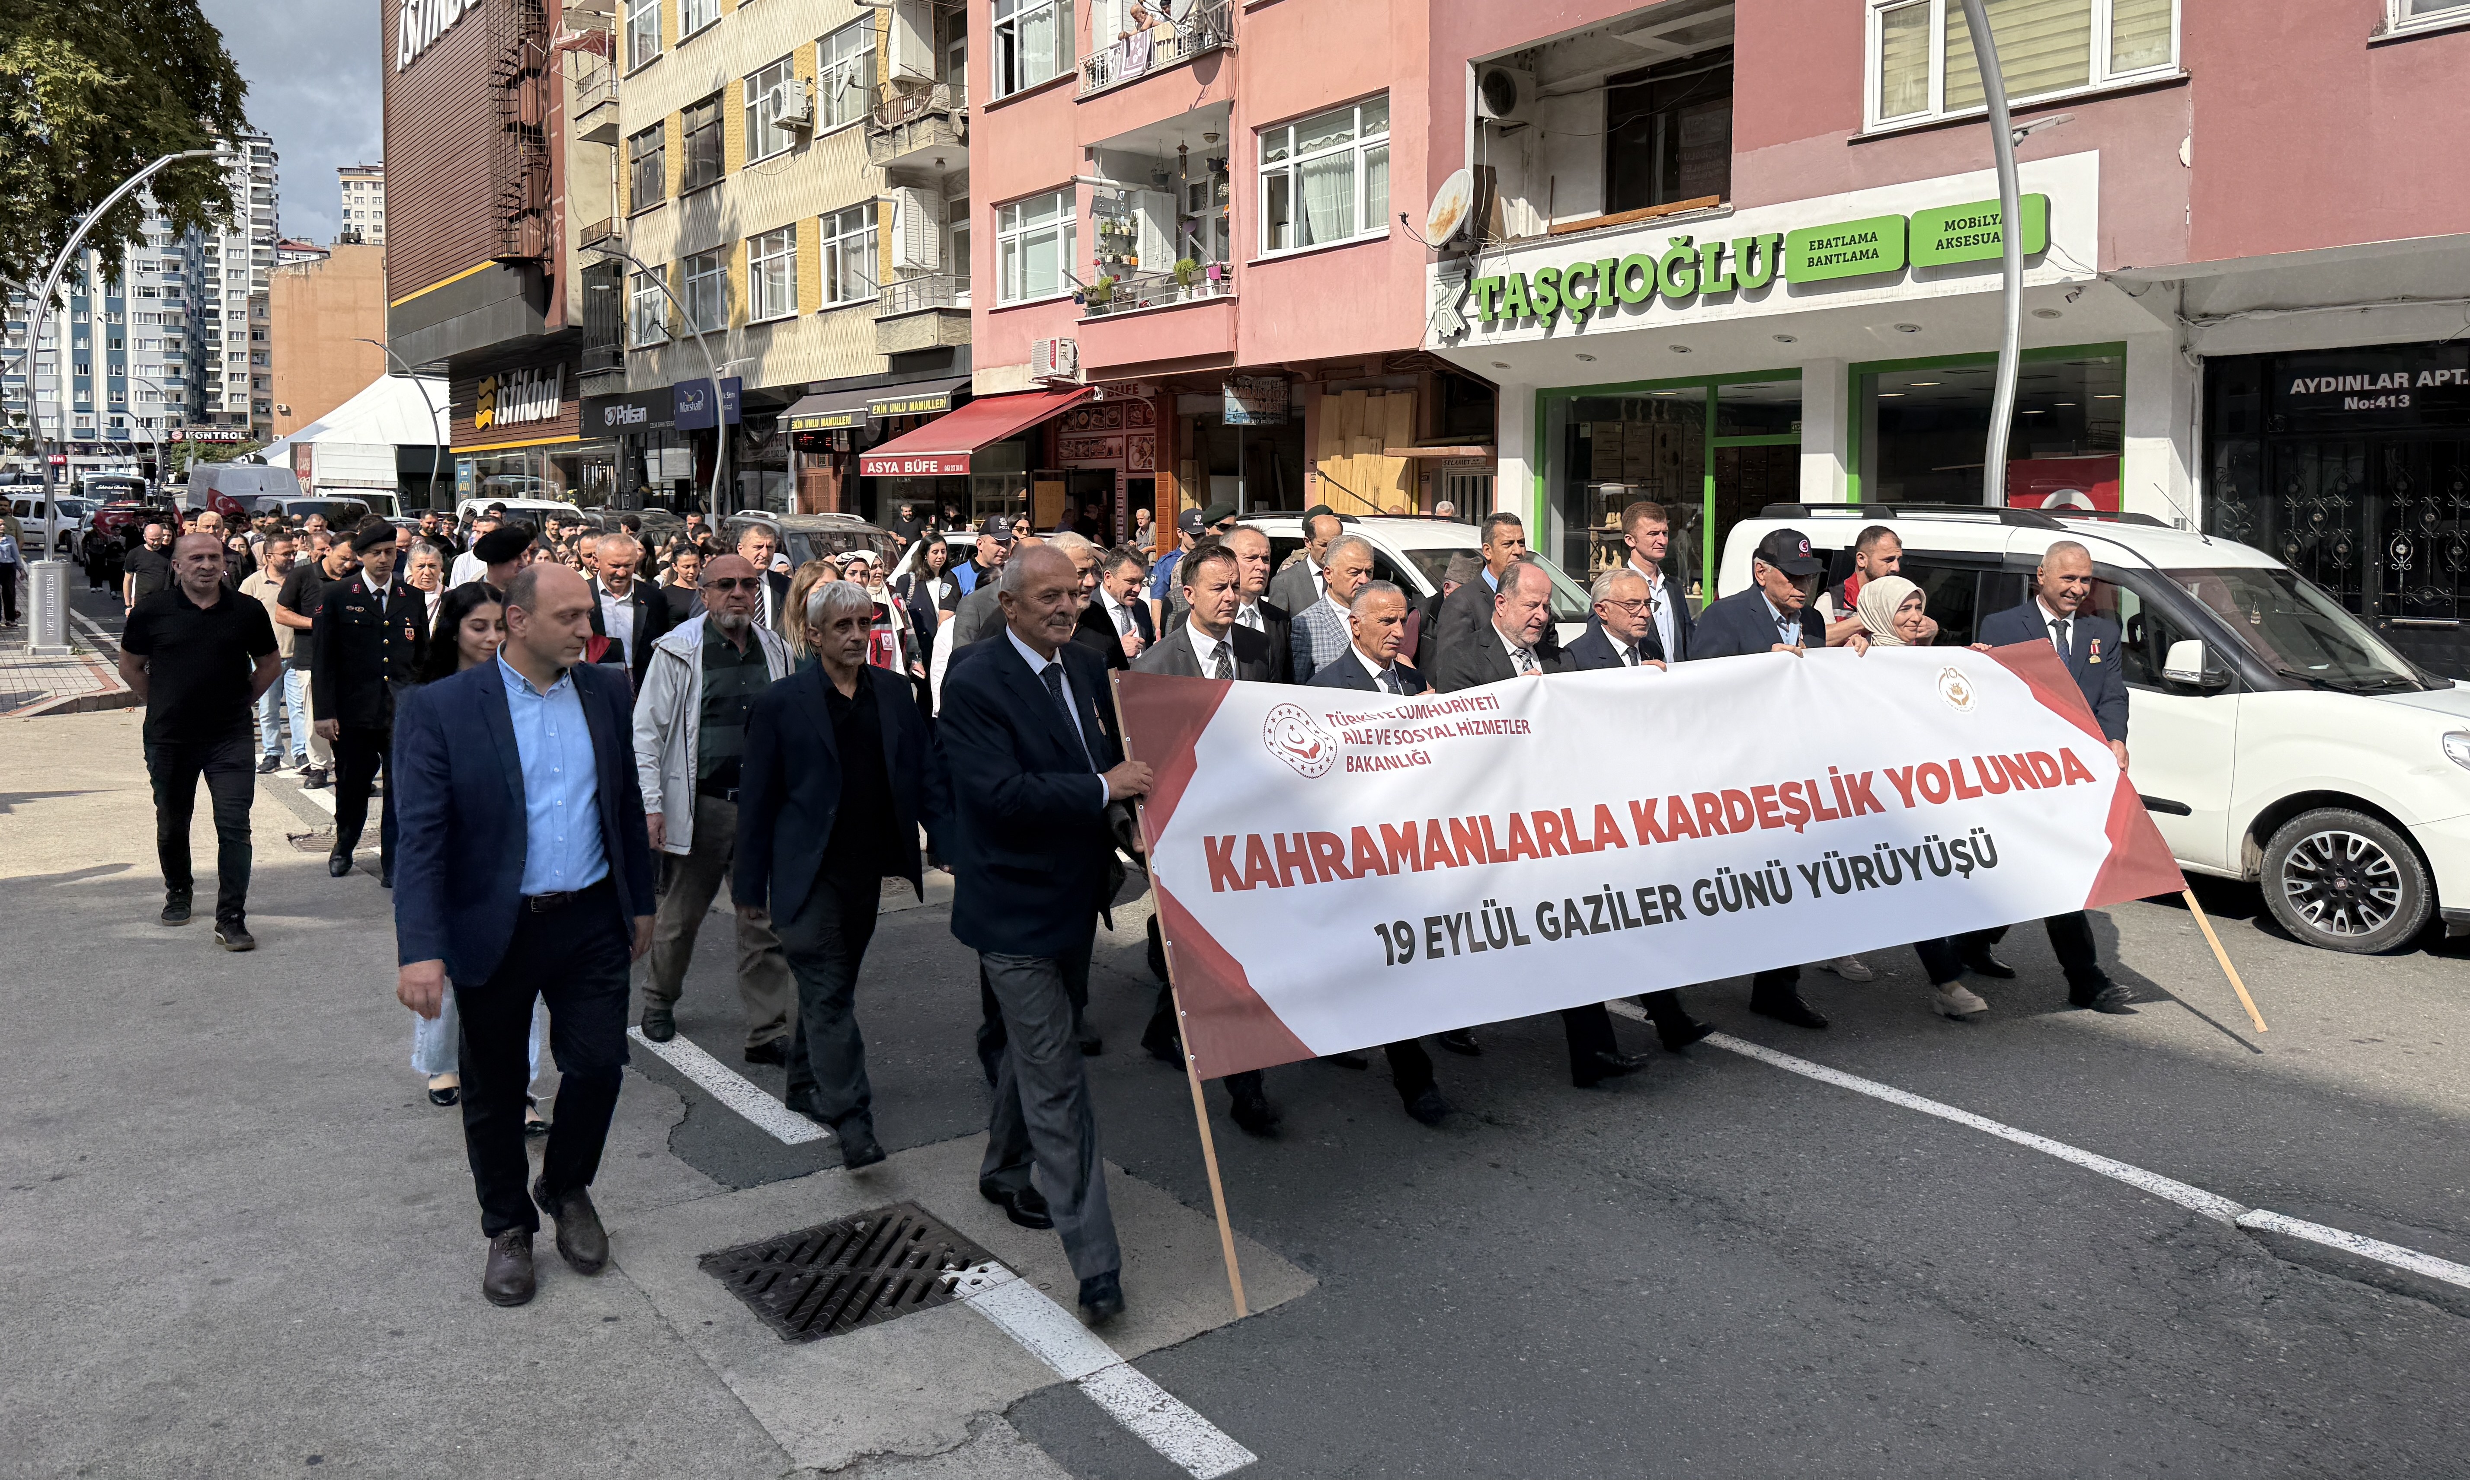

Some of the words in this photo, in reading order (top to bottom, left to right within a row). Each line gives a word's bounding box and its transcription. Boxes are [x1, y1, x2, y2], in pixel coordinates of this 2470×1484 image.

[1809, 231, 1878, 251] EBATLAMA
[1935, 231, 2003, 250] AKSESUA
[1807, 248, 1879, 267] BANTLAMA
[1472, 234, 1784, 327] TAŞÇIOĞLU
[1107, 382, 1139, 397] BÜFE
[2290, 372, 2409, 394] AYDINLAR
[2416, 369, 2469, 387] APT.
[494, 362, 564, 425] istikbal
[2344, 395, 2409, 410] No:413
[617, 404, 647, 425] Polisan
[872, 402, 887, 415] EKİN
[889, 402, 906, 413] UNLU
[909, 396, 947, 411] MAMULLERİ
[805, 417, 819, 428] UNLU
[821, 413, 851, 427] MAMULLERİ
[186, 432, 246, 440] KONTROL
[867, 461, 899, 473] ASYA
[904, 459, 938, 473] BÜFE
[1325, 710, 1396, 728] TÜRKİYE
[1396, 693, 1501, 723] CUMHURİYETİ
[1342, 728, 1373, 745] AİLE
[1376, 729, 1392, 746] VE
[1395, 724, 1456, 745] SOSYAL
[1459, 717, 1531, 736] HİZMETLER
[1346, 749, 1432, 773] BAKANLIĞI
[1204, 804, 1629, 892] KAHRAMANLARLA
[1631, 766, 1887, 835] KARDEŞLİK
[1882, 747, 2097, 810] YOLUNDA
[1374, 920, 1415, 966] 19
[1424, 899, 1530, 960] EYLÜL
[1536, 883, 1687, 942] GAZİLER
[1693, 859, 1793, 916] GÜNÜ
[1797, 827, 1998, 898] YÜRÜYÜŞÜ
